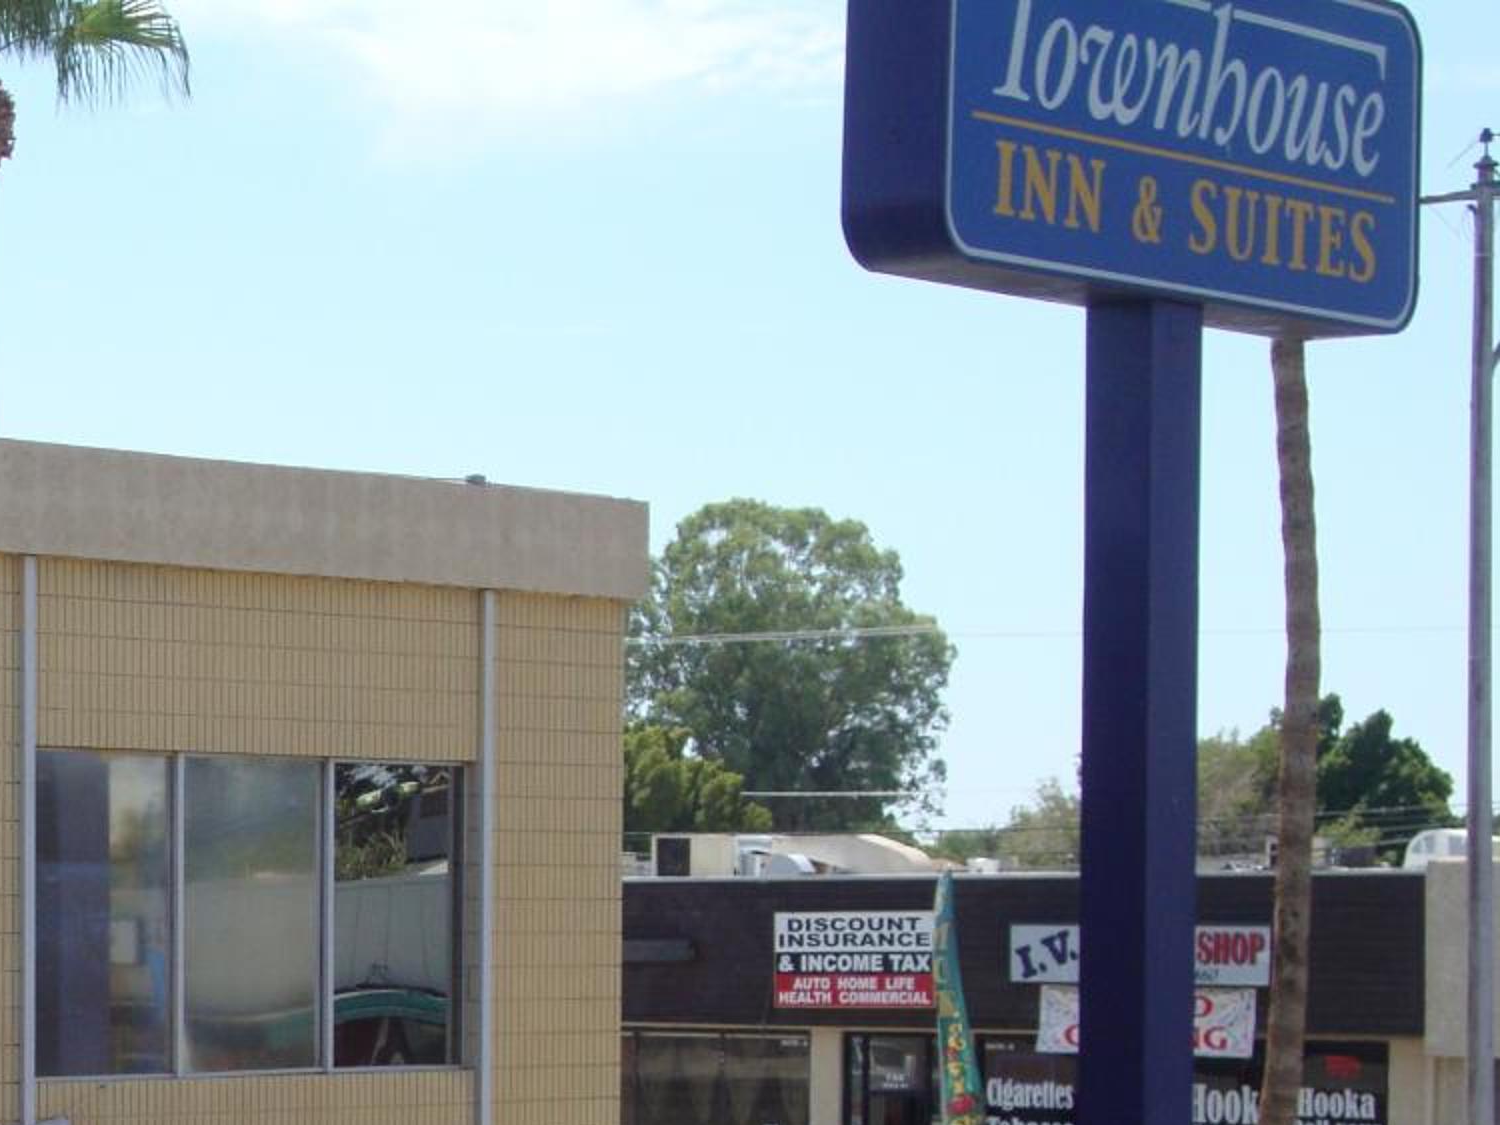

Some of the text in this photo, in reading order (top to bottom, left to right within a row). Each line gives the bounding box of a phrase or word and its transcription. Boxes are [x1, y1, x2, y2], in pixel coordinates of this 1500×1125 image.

[994, 0, 1387, 177] Townhouse
[994, 141, 1377, 283] INN & SUITES
[787, 917, 922, 932] DISCOUNT
[779, 932, 930, 947] INSURANCE
[1197, 931, 1265, 965] SHOP
[779, 954, 931, 972] & INCOME TAX
[793, 977, 915, 990] AUTO HOME LIFE
[779, 991, 931, 1004] HEALTH COMMERCIAL
[986, 1078, 1074, 1111] Cigarettes
[1297, 1087, 1376, 1119] Hooka
